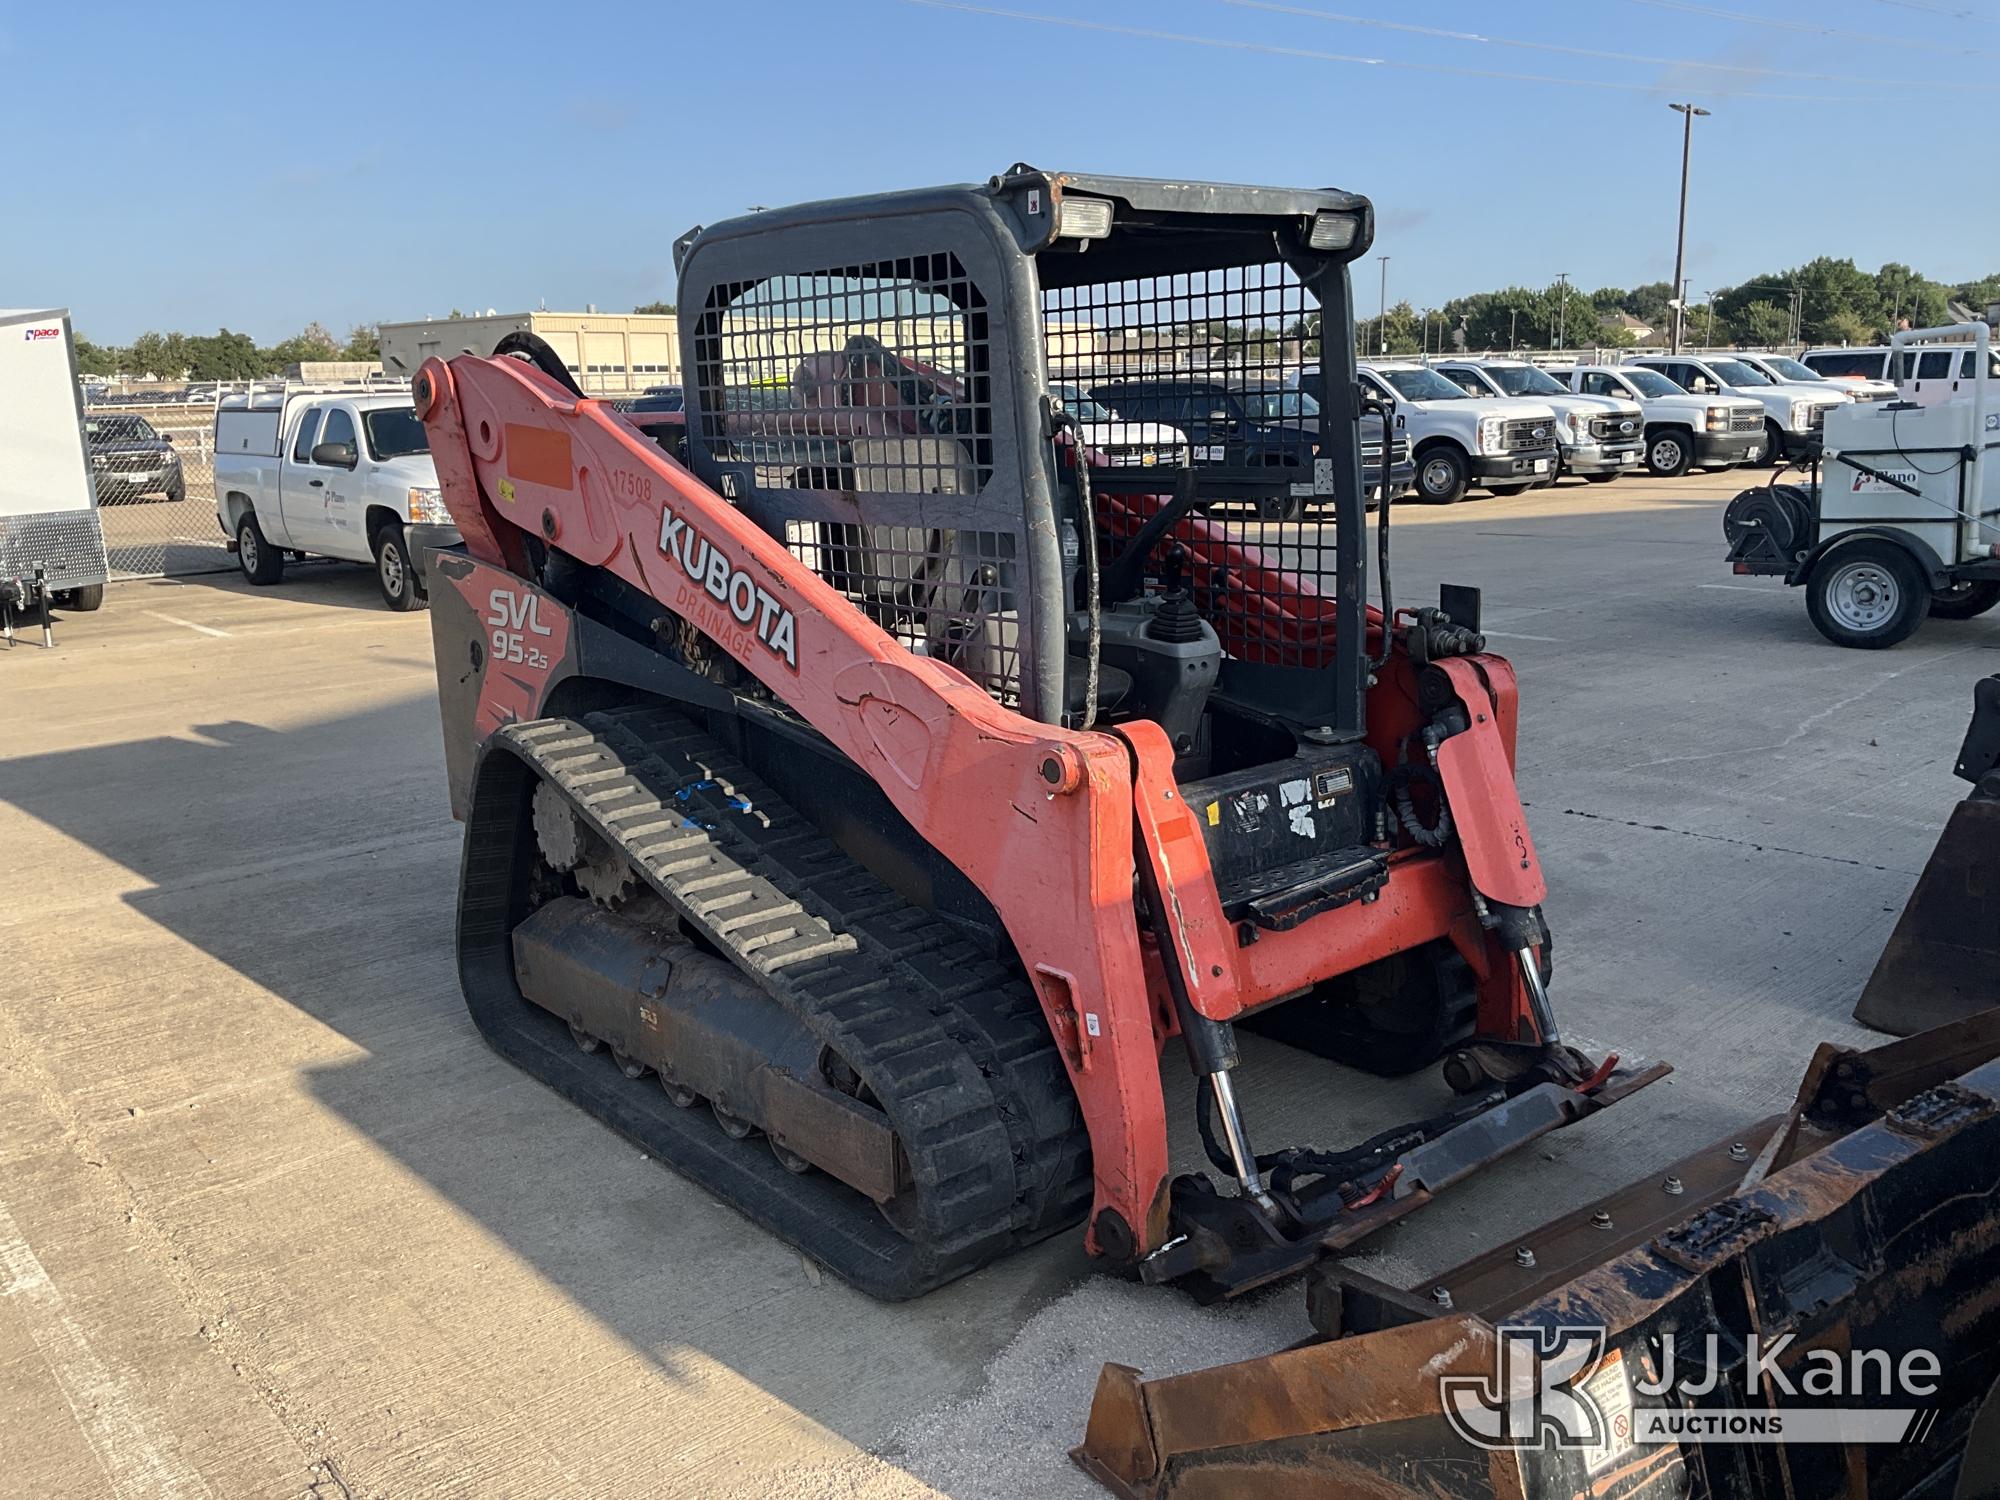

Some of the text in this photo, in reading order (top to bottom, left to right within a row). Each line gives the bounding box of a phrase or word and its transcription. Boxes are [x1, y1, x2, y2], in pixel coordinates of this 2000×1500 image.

[613, 469, 652, 500] 17508
[488, 589, 551, 636] SVL
[658, 505, 797, 669] KUBOTA
[676, 584, 755, 663] DRAINAGE
